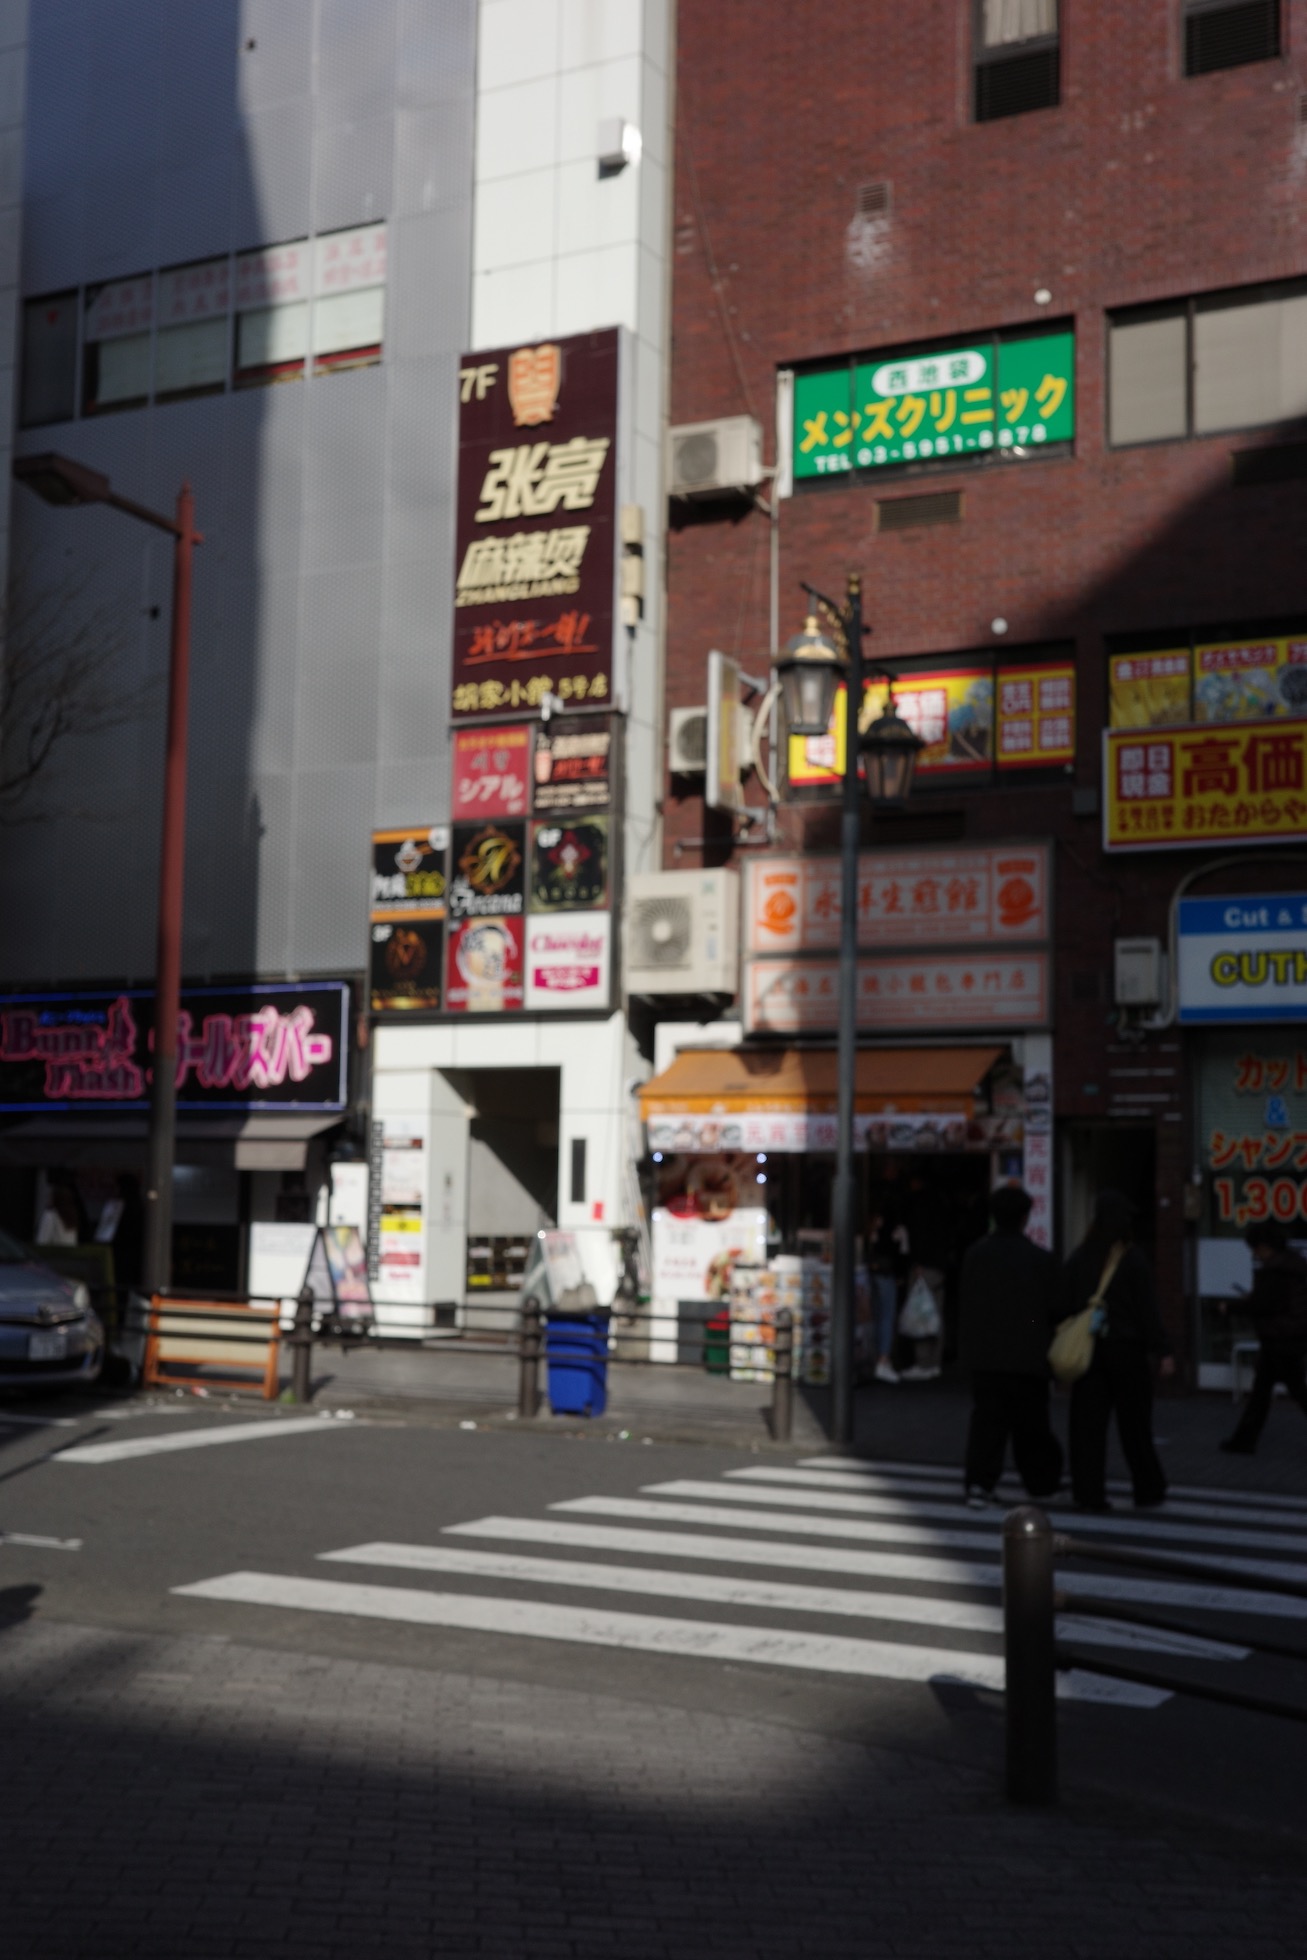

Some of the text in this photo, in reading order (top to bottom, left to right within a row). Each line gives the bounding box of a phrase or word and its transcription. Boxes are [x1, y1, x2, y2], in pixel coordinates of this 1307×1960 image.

[458, 364, 499, 402] 7F
[800, 374, 1069, 453] メンズクリニック
[475, 437, 610, 523] 张亮
[814, 453, 852, 473] TEL
[1180, 733, 1305, 798] 高価
[1183, 797, 1307, 830] おたからや
[1223, 906, 1292, 928] Cut &
[1265, 1096, 1289, 1127] &
[1214, 1177, 1307, 1225] 1,30
